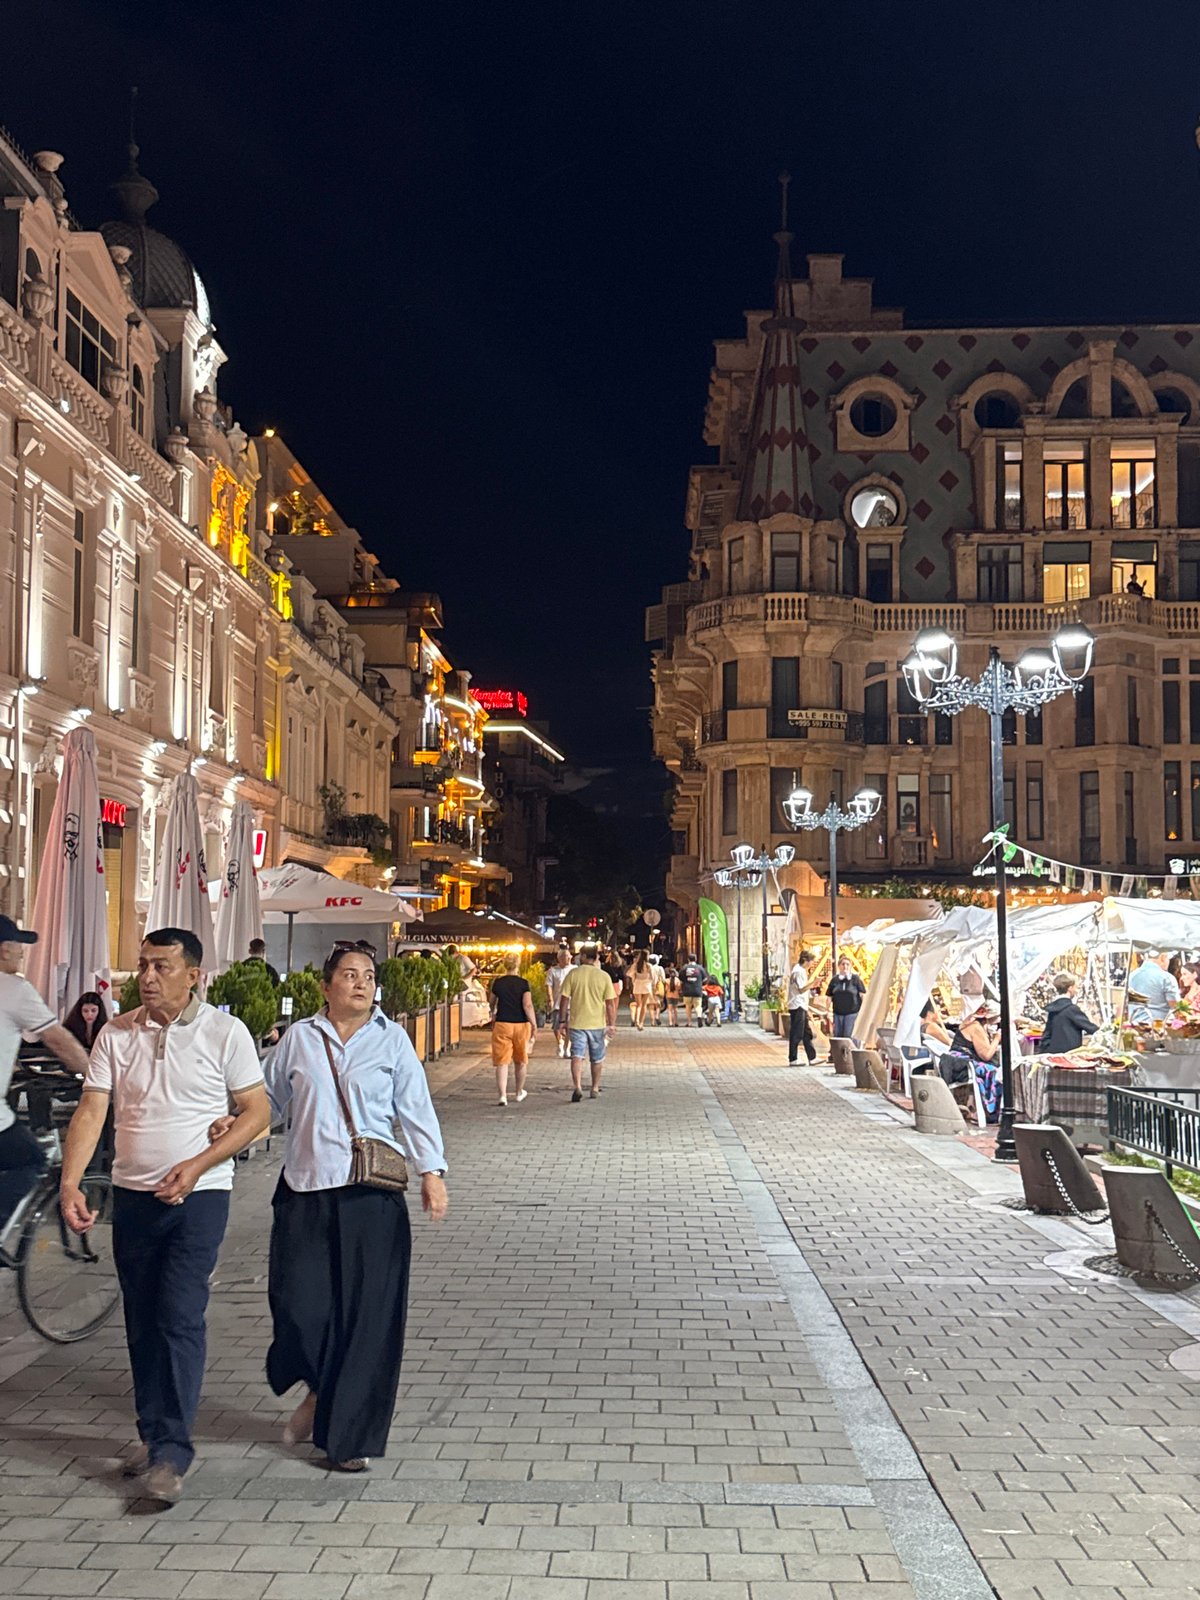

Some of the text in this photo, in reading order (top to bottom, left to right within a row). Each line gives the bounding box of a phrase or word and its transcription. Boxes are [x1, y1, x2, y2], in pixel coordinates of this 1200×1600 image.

[484, 702, 491, 710] by
[790, 711, 847, 721] SALE RENT
[102, 799, 126, 827] KFC
[494, 772, 504, 844] HOL
[325, 896, 363, 907] KFC
[440, 934, 478, 942] WAFFLE
